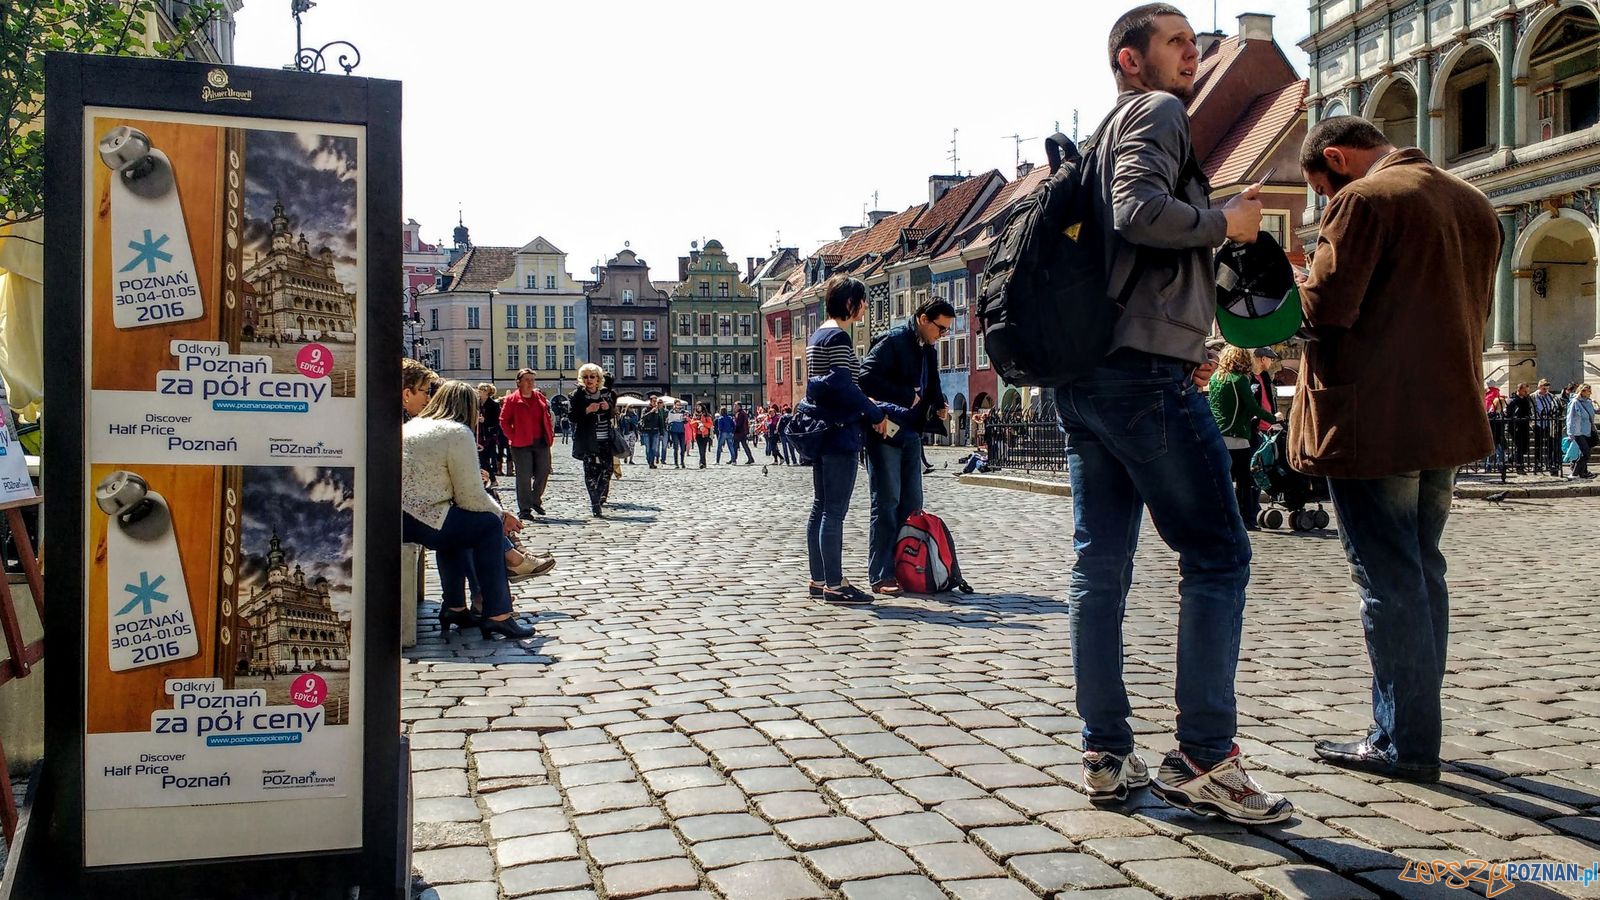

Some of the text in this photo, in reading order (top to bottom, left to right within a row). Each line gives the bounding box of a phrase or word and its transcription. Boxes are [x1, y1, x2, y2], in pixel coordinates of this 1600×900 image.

[119, 270, 189, 292] POZNAŃ
[116, 286, 196, 306] 30.04-01.05
[136, 301, 185, 322] 2016
[177, 343, 221, 356] Odkryj
[310, 349, 324, 366] 9.
[186, 355, 267, 373] Poznań
[300, 361, 325, 375] EDYCJA
[161, 378, 193, 395] za
[203, 375, 249, 400] pół
[259, 381, 327, 402] ceny
[216, 402, 306, 411] www.poznanzapolceny.pl
[145, 413, 192, 423] Discover
[109, 424, 175, 435] Half Price
[168, 437, 237, 451] Poznań
[115, 610, 184, 635] POZNAŃ
[111, 625, 192, 649] 30.04-01.05
[132, 642, 180, 664] 2016
[172, 681, 215, 693] Odkryj
[304, 678, 318, 695] 9.
[180, 691, 261, 709] Poznań
[294, 692, 318, 704] EDYCJA
[155, 711, 320, 736] za pół ceny
[210, 735, 299, 744] www.poznanzapolceny.pl
[140, 753, 186, 763] Discover
[104, 764, 169, 777] Half Price
[162, 773, 231, 789] Poznań
